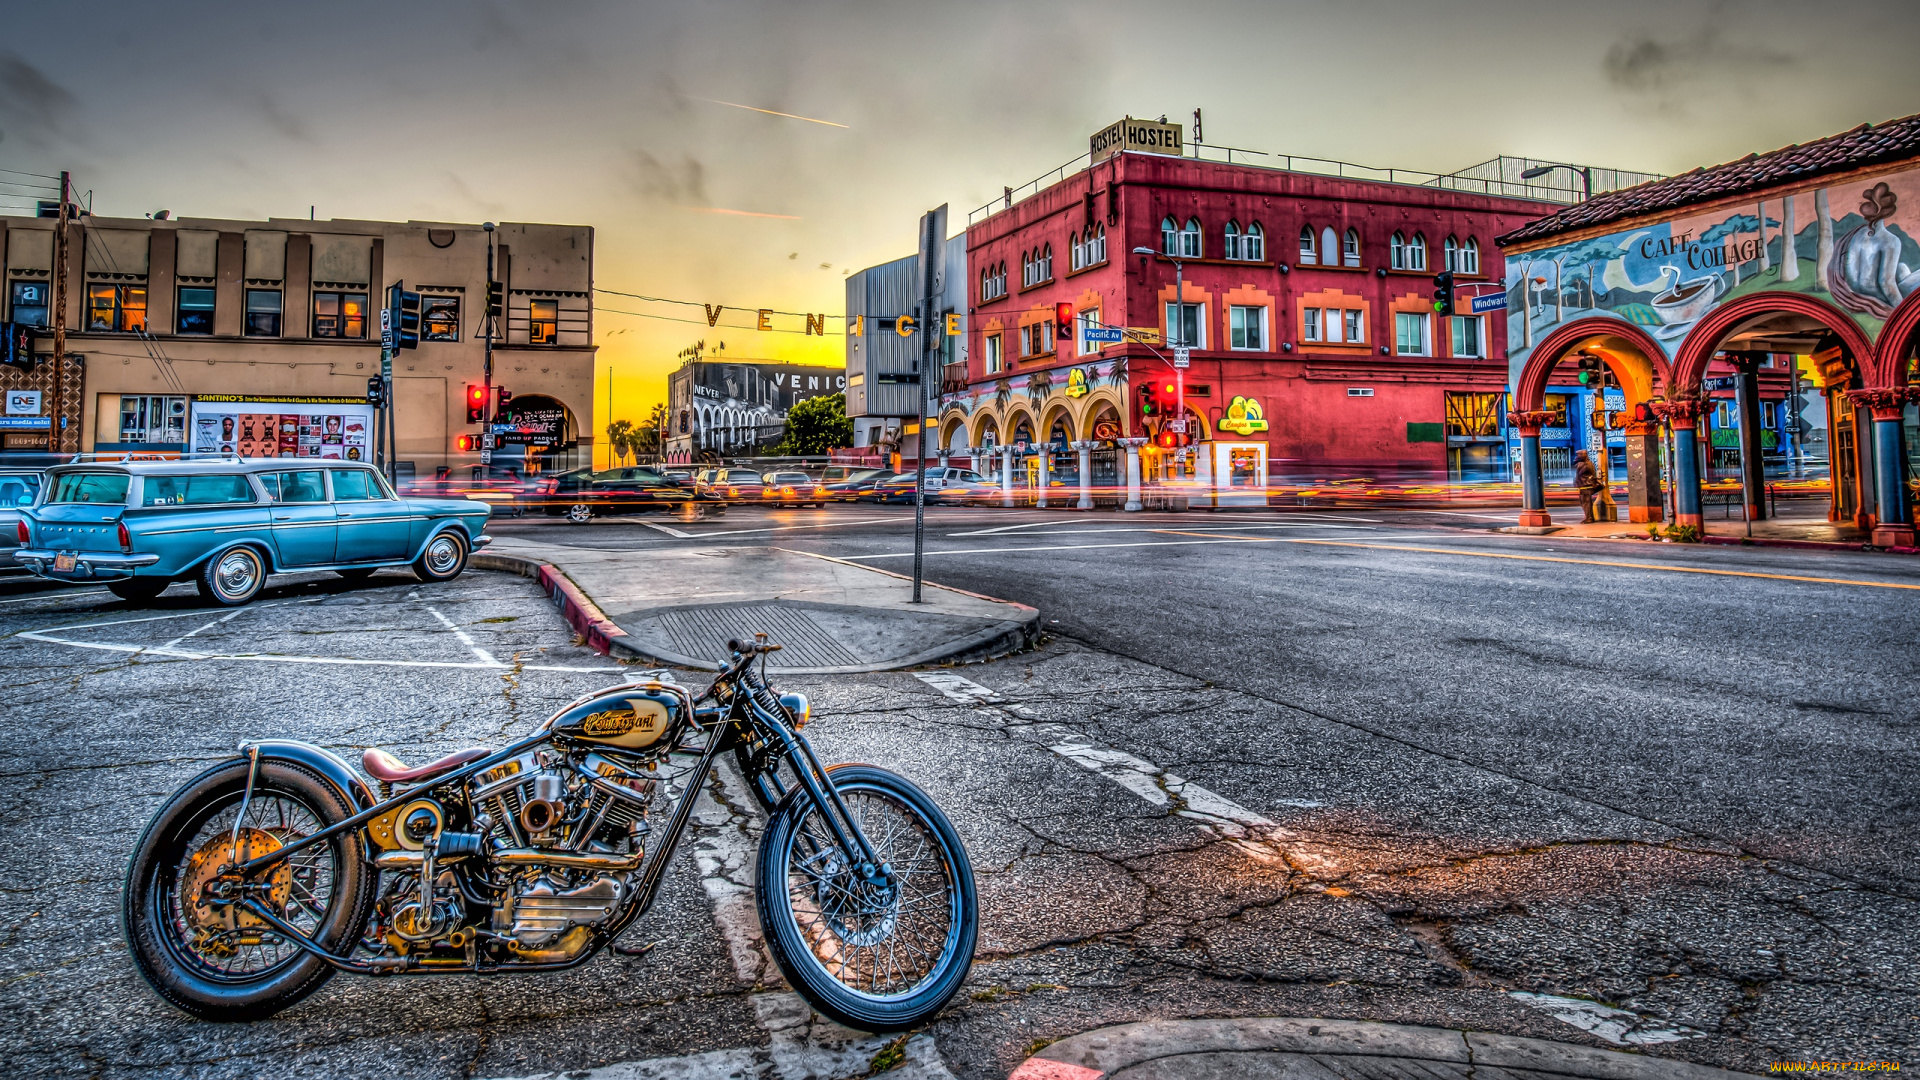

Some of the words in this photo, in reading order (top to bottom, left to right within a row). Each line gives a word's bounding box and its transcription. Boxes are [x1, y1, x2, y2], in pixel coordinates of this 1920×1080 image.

[1091, 124, 1122, 155] HOSTEL
[1128, 126, 1180, 148] HOSTEL
[1640, 228, 1694, 259] CAFÉ
[1687, 238, 1765, 271] COLLAGE
[23, 286, 38, 300] a
[704, 303, 962, 337] VENICE
[1087, 329, 1110, 339] Pacific
[1111, 330, 1120, 339] Av
[197, 394, 244, 402] SANTINO'S
[694, 384, 719, 398] NEVER
